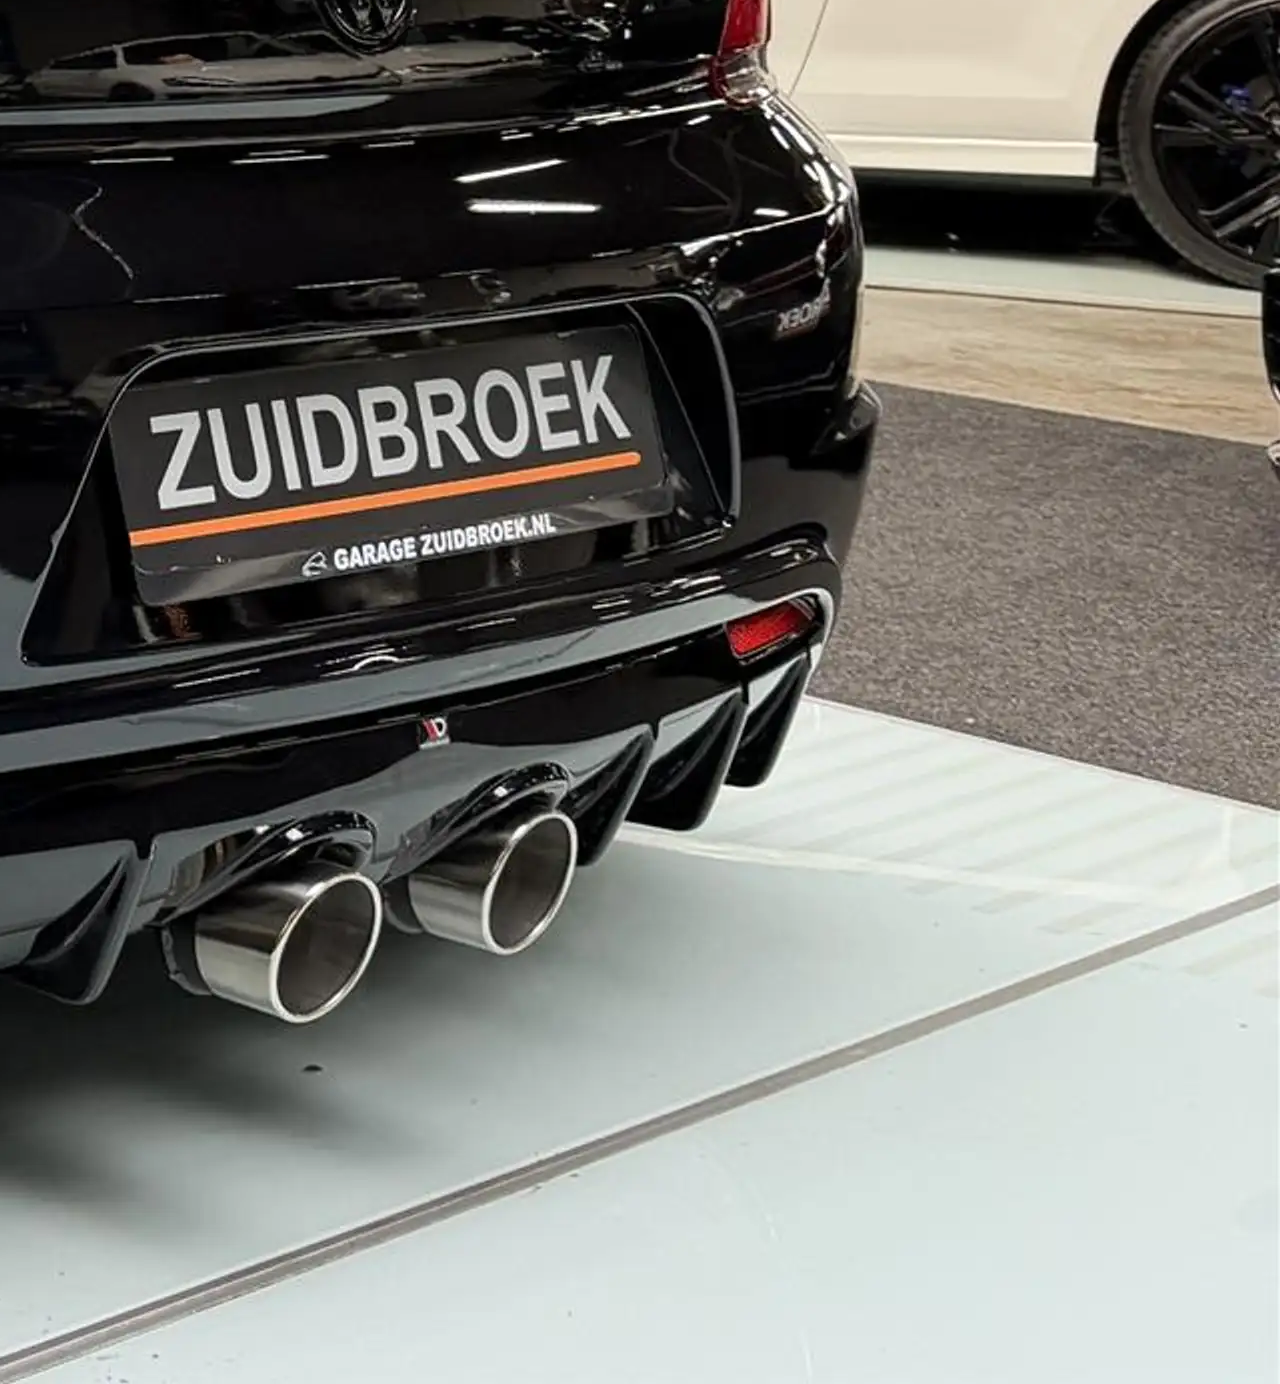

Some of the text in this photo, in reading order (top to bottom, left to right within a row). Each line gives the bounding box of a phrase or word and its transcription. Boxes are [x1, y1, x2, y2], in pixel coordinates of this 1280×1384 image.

[149, 355, 632, 510] ZUIDBROEK
[333, 513, 557, 571] GARAGE ZUIDBROEK.NL
